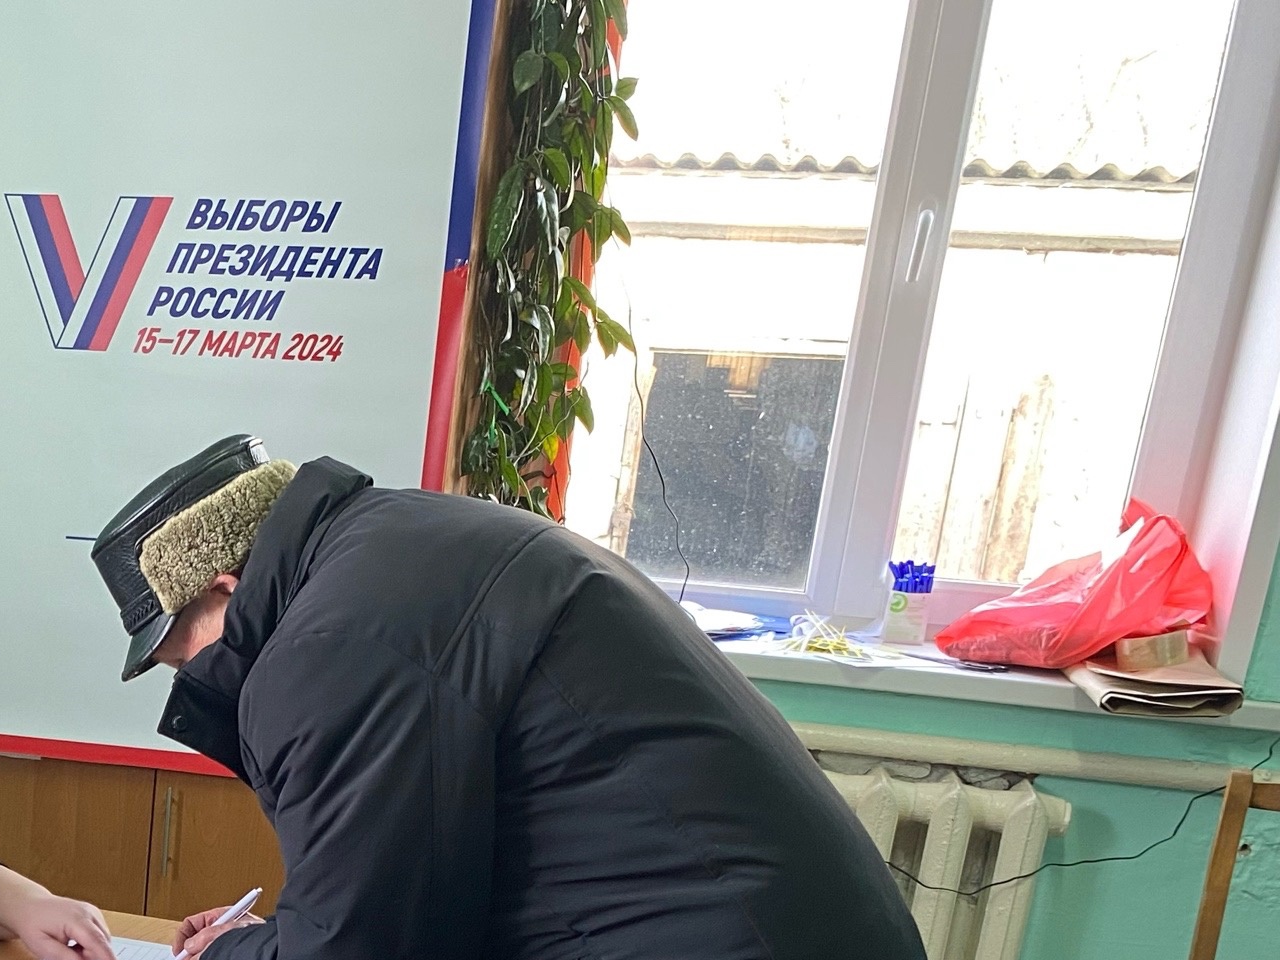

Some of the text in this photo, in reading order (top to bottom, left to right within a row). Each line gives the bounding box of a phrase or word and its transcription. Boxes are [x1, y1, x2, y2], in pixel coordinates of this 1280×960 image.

[186, 198, 342, 233] ВЫБОРЫ
[166, 242, 384, 282] ПРЕЗИДЕНТА
[147, 286, 285, 321] РОССИИ
[198, 330, 279, 360] МАРТА
[282, 334, 345, 362] 2024
